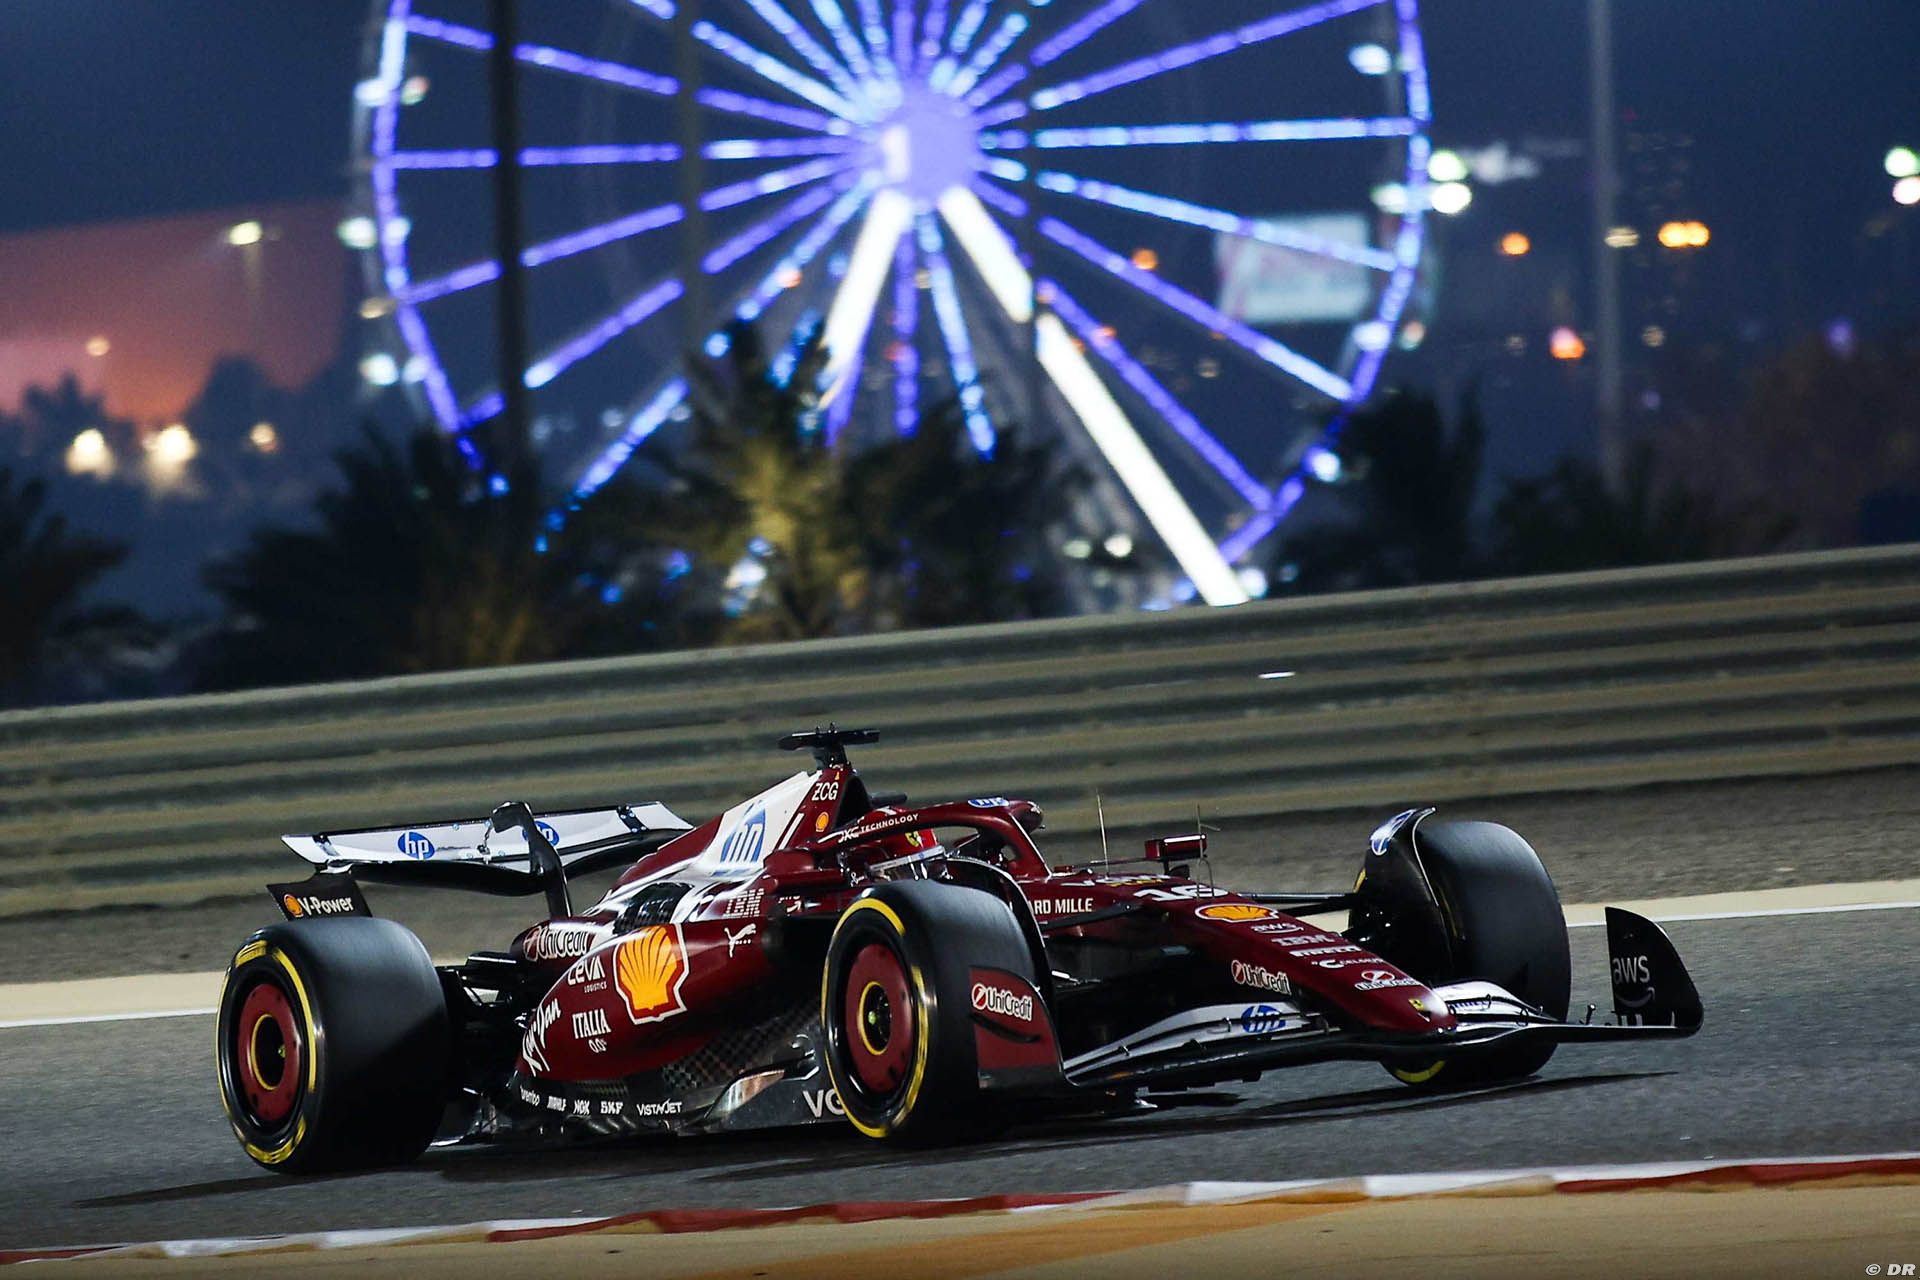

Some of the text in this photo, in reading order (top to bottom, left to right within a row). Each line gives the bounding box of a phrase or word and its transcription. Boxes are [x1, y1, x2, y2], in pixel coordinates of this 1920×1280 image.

[812, 782, 839, 800] ZCG
[861, 813, 919, 834] TECHNOLOGY
[406, 832, 430, 860] hp
[297, 896, 354, 916] V-Power
[723, 889, 764, 918] IBM
[1055, 898, 1094, 913] MILLE
[536, 925, 588, 959] UniCredit
[1272, 935, 1335, 946] IBM
[1243, 964, 1292, 995] UniCredit
[1612, 956, 1650, 984] aws
[988, 991, 1034, 1022] UniCredit
[572, 1008, 612, 1039] ITALIA
